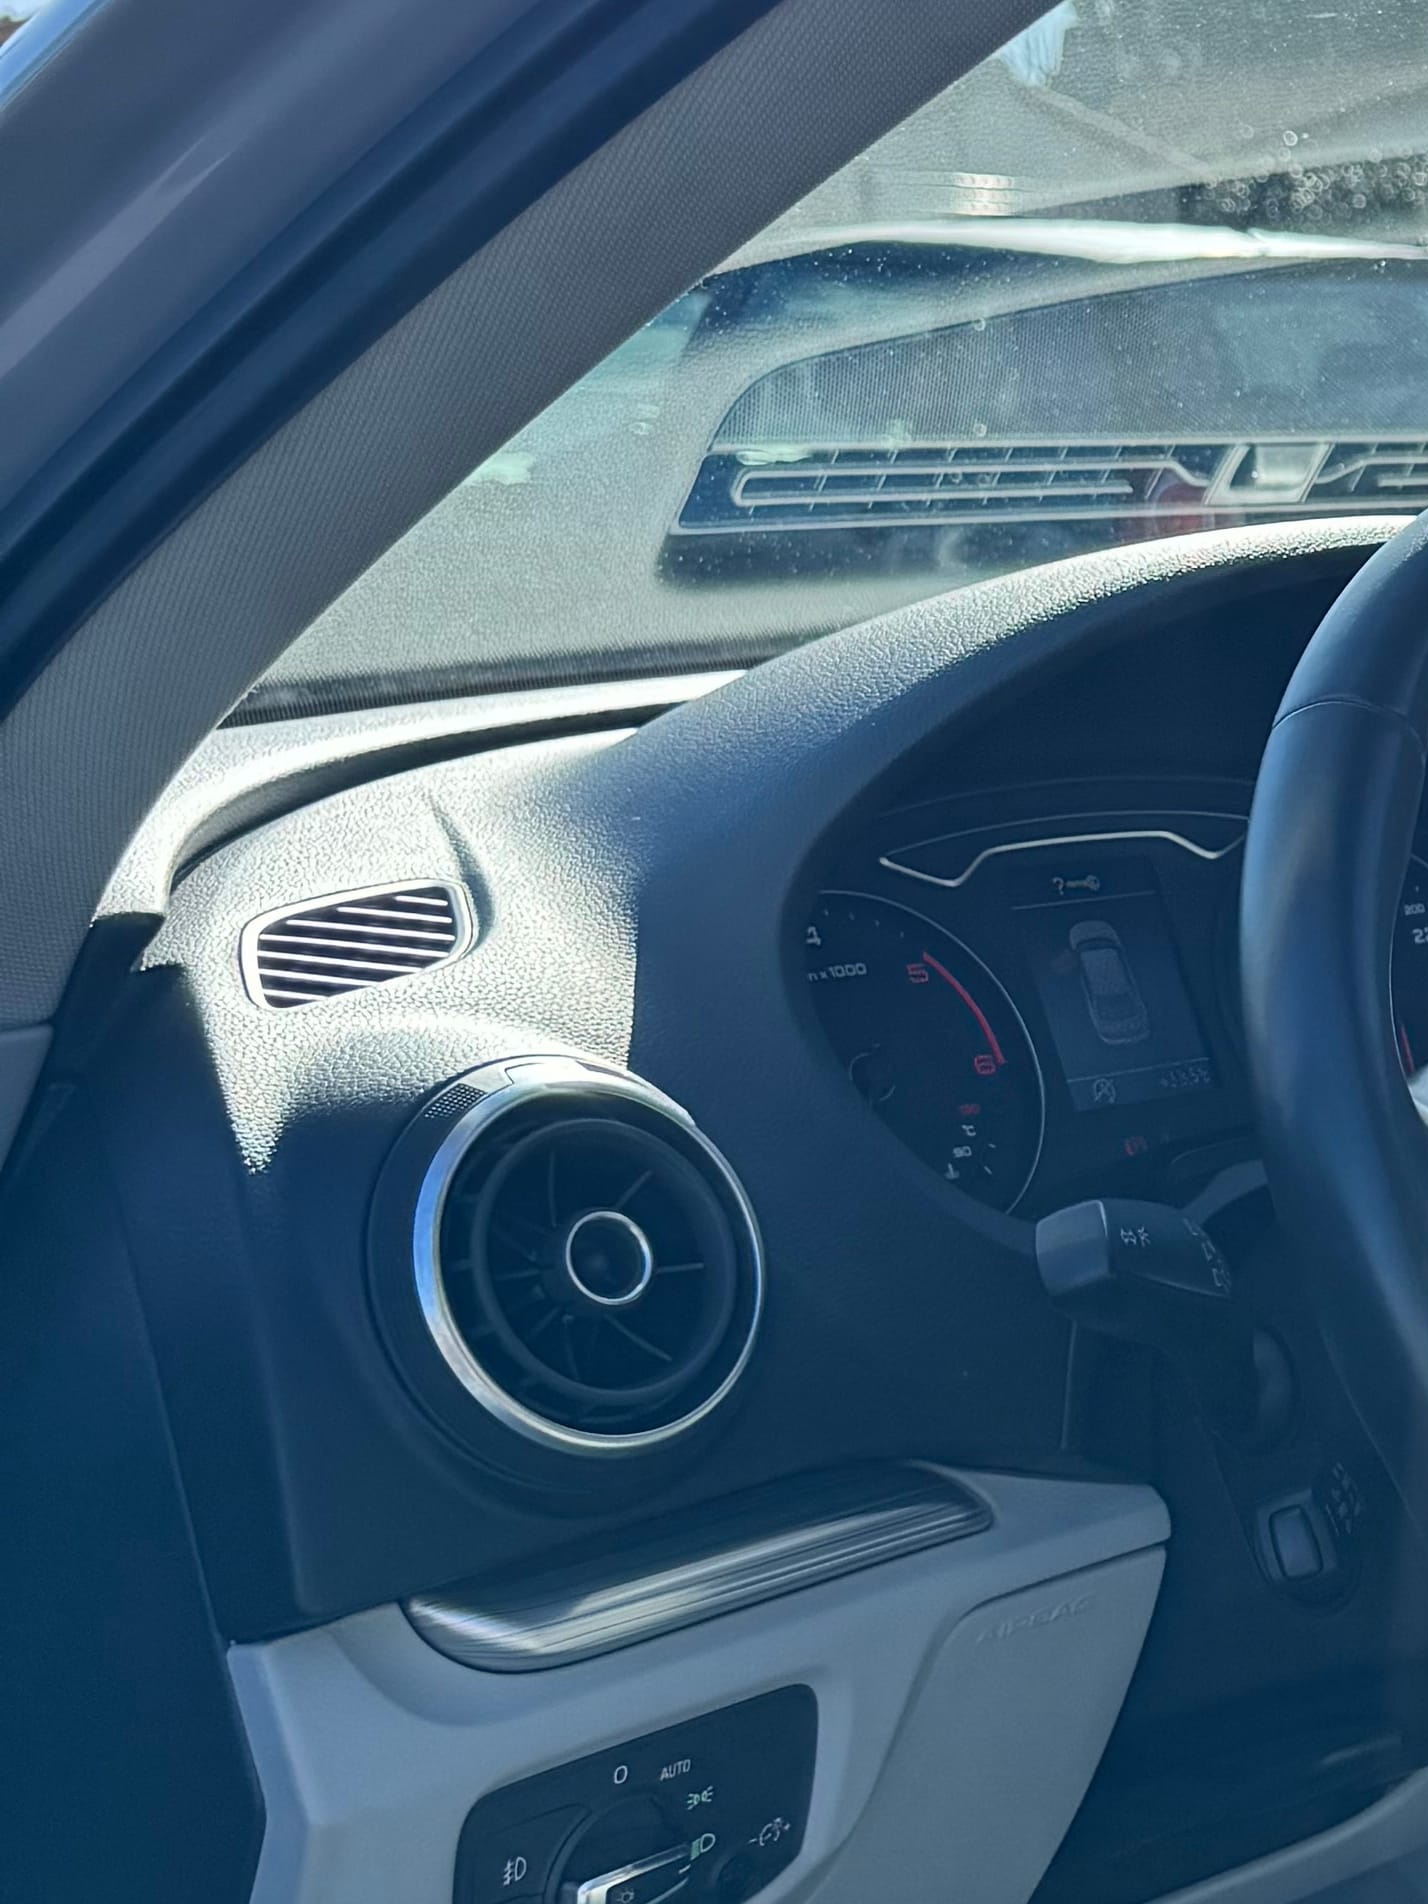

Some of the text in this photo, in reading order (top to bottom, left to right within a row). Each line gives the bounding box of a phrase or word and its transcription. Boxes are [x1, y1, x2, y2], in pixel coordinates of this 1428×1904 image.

[904, 962, 930, 985] 5
[974, 1054, 996, 1074] 6
[659, 1758, 692, 1782] AUTO
